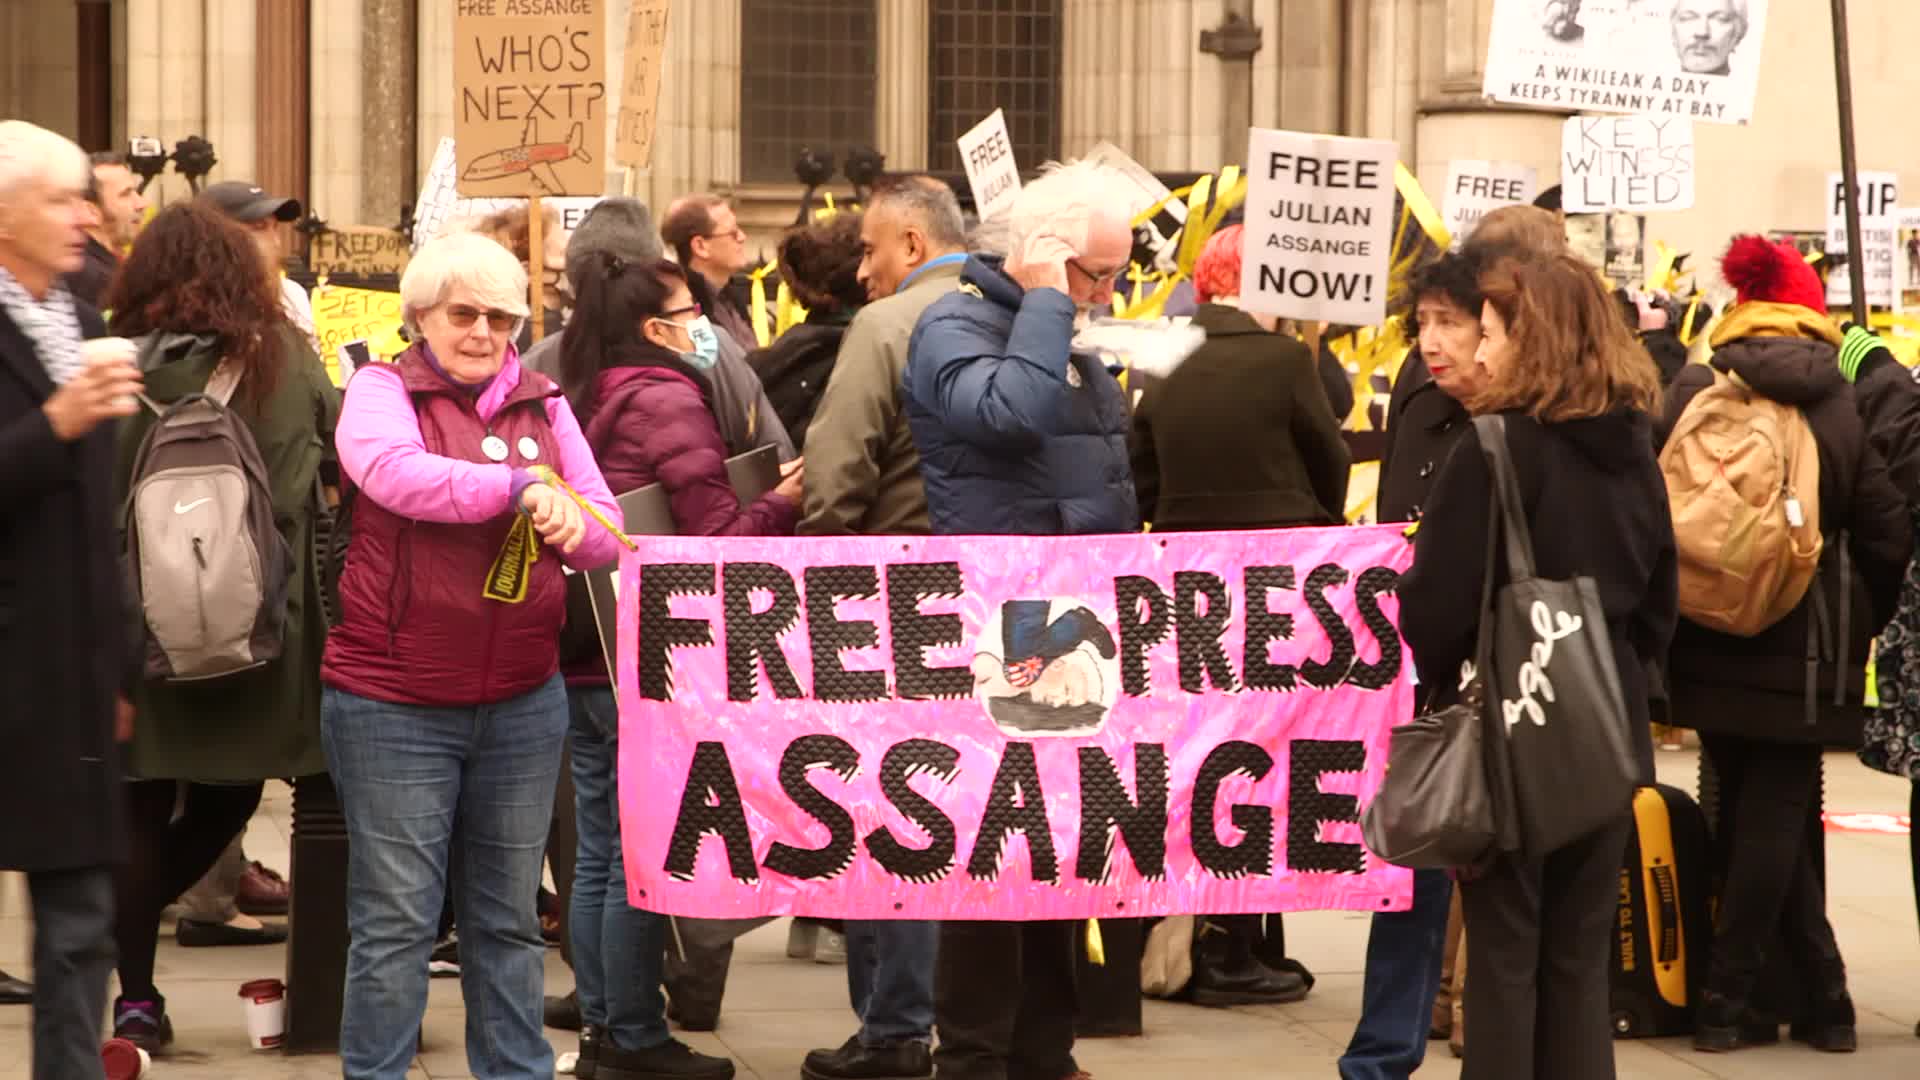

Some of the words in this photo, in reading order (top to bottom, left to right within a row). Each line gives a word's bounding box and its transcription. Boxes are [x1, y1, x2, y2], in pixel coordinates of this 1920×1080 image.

[458, 0, 496, 16] FREE
[505, 0, 592, 15] ASSANGE
[475, 25, 591, 73] WHO'S
[1536, 64, 1545, 78] A
[1555, 65, 1644, 89] WIKILEAK
[1652, 76, 1663, 91] A
[1671, 77, 1710, 96] DAY
[463, 82, 605, 123] NEXT?
[1510, 82, 1562, 101] KEEPS
[1569, 88, 1653, 110] TYRANNY
[1661, 99, 1683, 114] AT
[1690, 101, 1726, 119] BAY
[1580, 117, 1672, 152] KEY
[969, 131, 1006, 177] FREE
[1269, 151, 1380, 189] FREE
[1566, 144, 1693, 176] WITNESS
[983, 172, 1013, 205] JULIAN
[1456, 173, 1525, 201] FREE
[1583, 175, 1681, 207] LIED
[1269, 199, 1372, 226] JULIAN
[1266, 233, 1371, 256] ASSANGE
[1258, 263, 1373, 302] NOW!
[638, 561, 975, 703] FREE
[1113, 562, 1403, 698] PRESS
[662, 734, 1368, 886] ASSANGE
